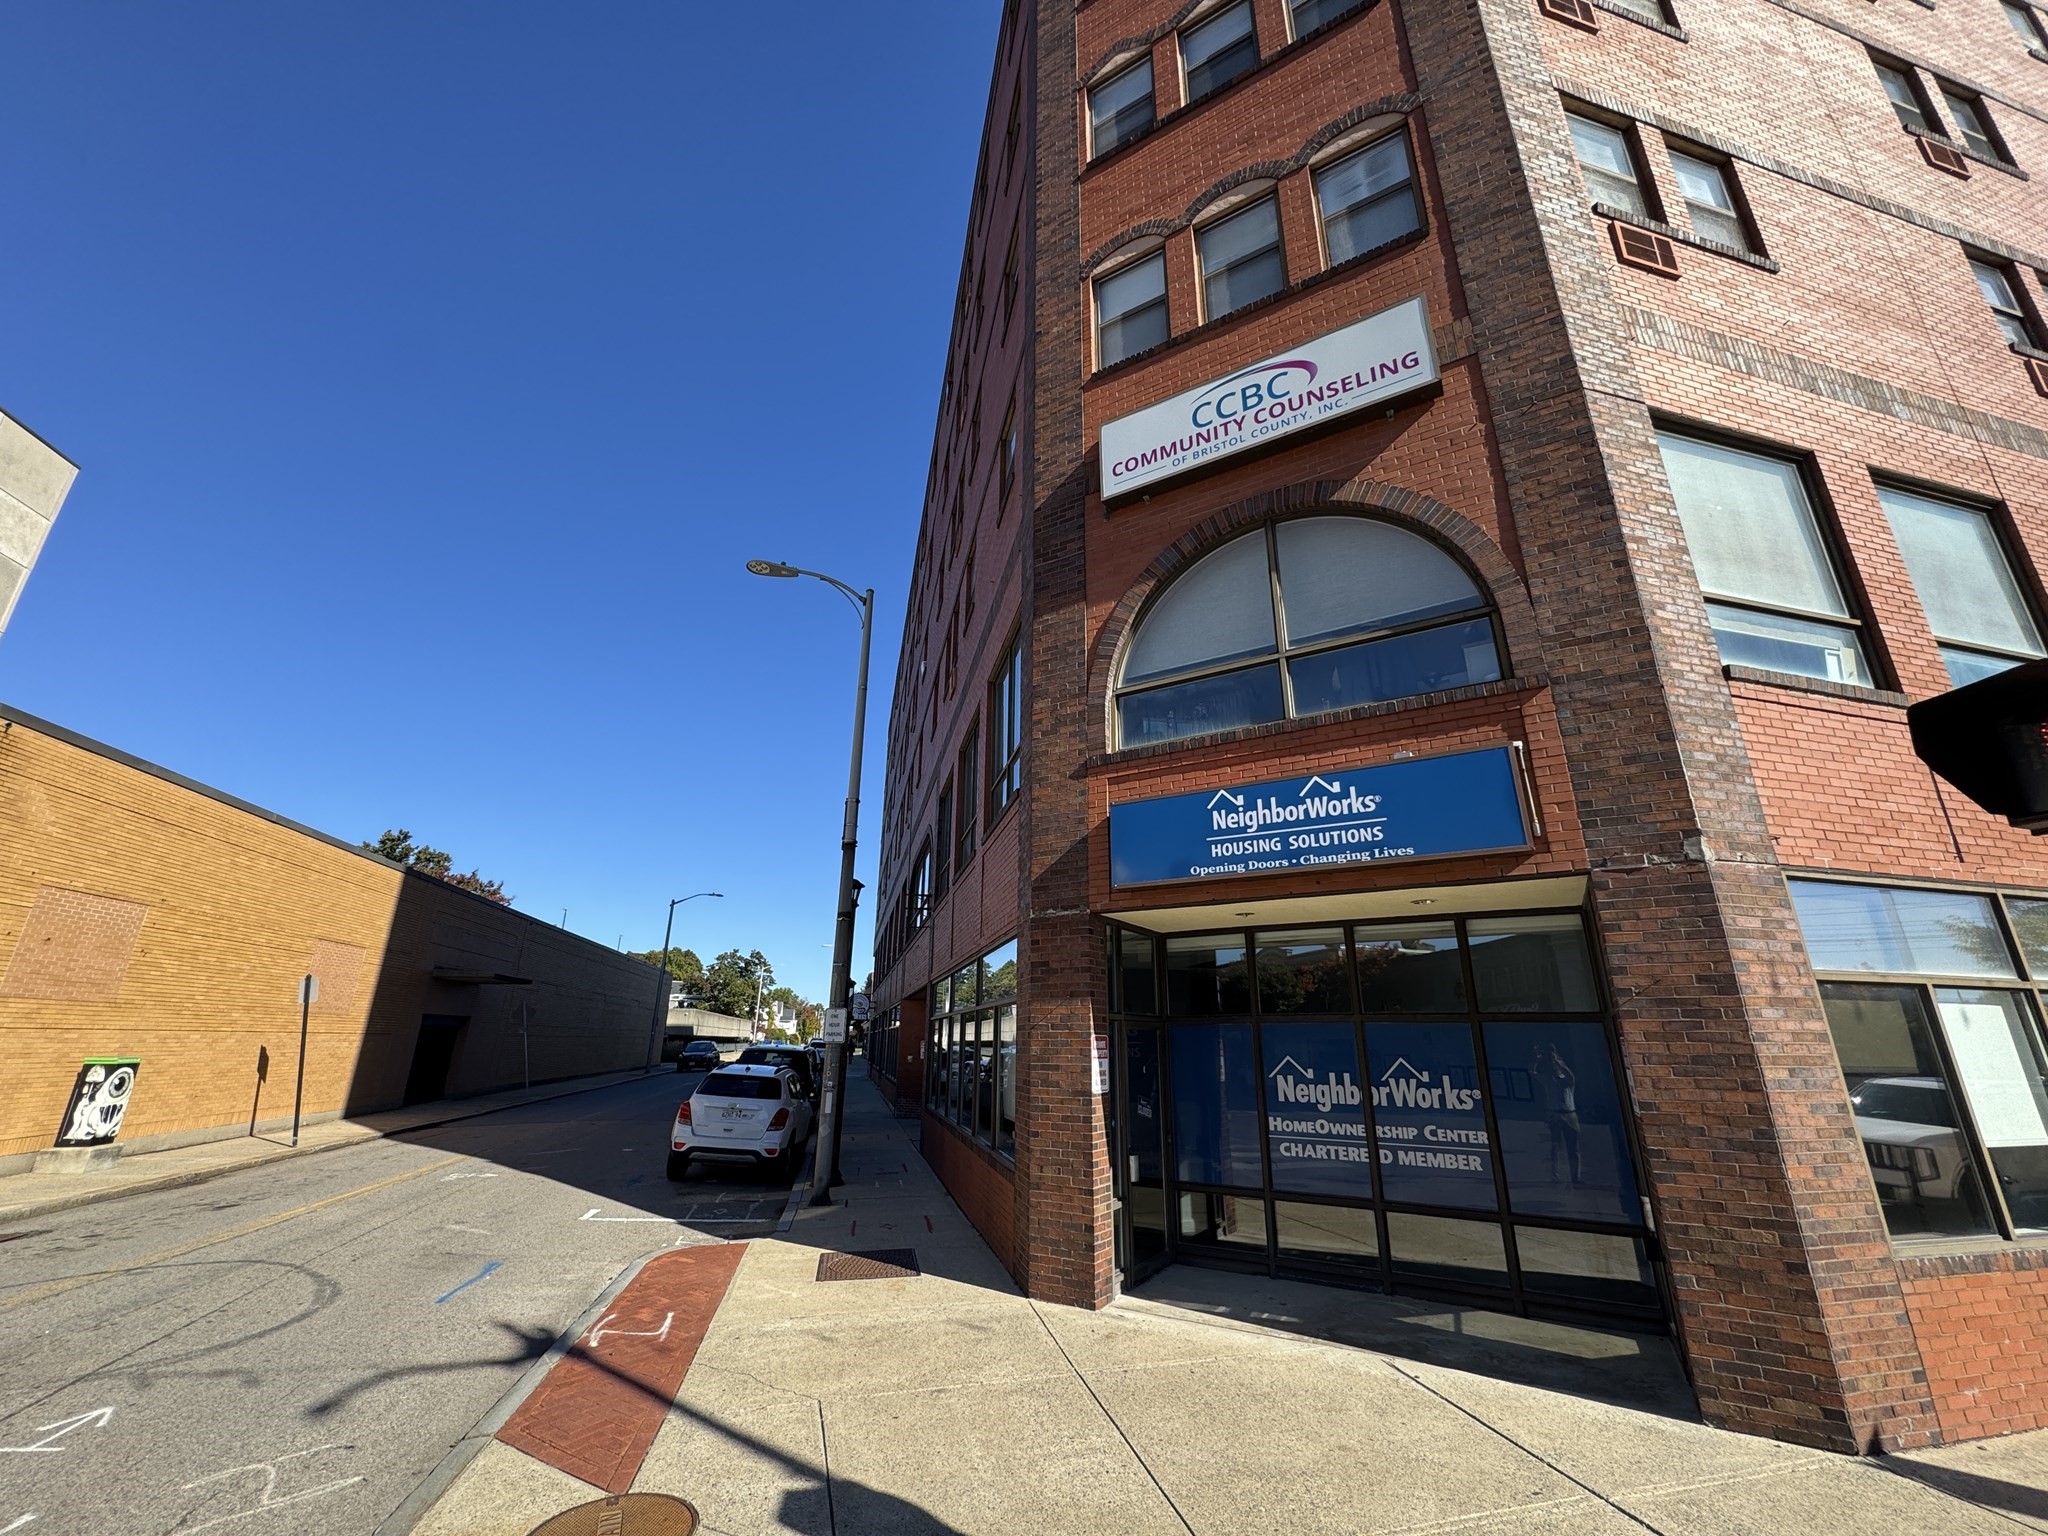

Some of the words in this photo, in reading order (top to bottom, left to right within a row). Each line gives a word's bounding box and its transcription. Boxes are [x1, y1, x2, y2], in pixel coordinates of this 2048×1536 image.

[1112, 415, 1247, 477] COMMUNITY
[1253, 350, 1420, 425] COUNSELING
[1191, 371, 1291, 428] CCBC
[1171, 453, 1189, 467] OF
[1192, 435, 1246, 461] BRISTOL
[1251, 412, 1312, 438] COUNTY,
[1318, 397, 1349, 415] INC.
[1190, 861, 1246, 877] Opening
[1248, 856, 1289, 869] Doors
[1300, 848, 1371, 867] Changing
[1373, 844, 1415, 858] Lives
[1211, 837, 1282, 858] HOUSING
[1288, 825, 1384, 850] SOLUTIONS
[1398, 1150, 1484, 1171] MEMBER
